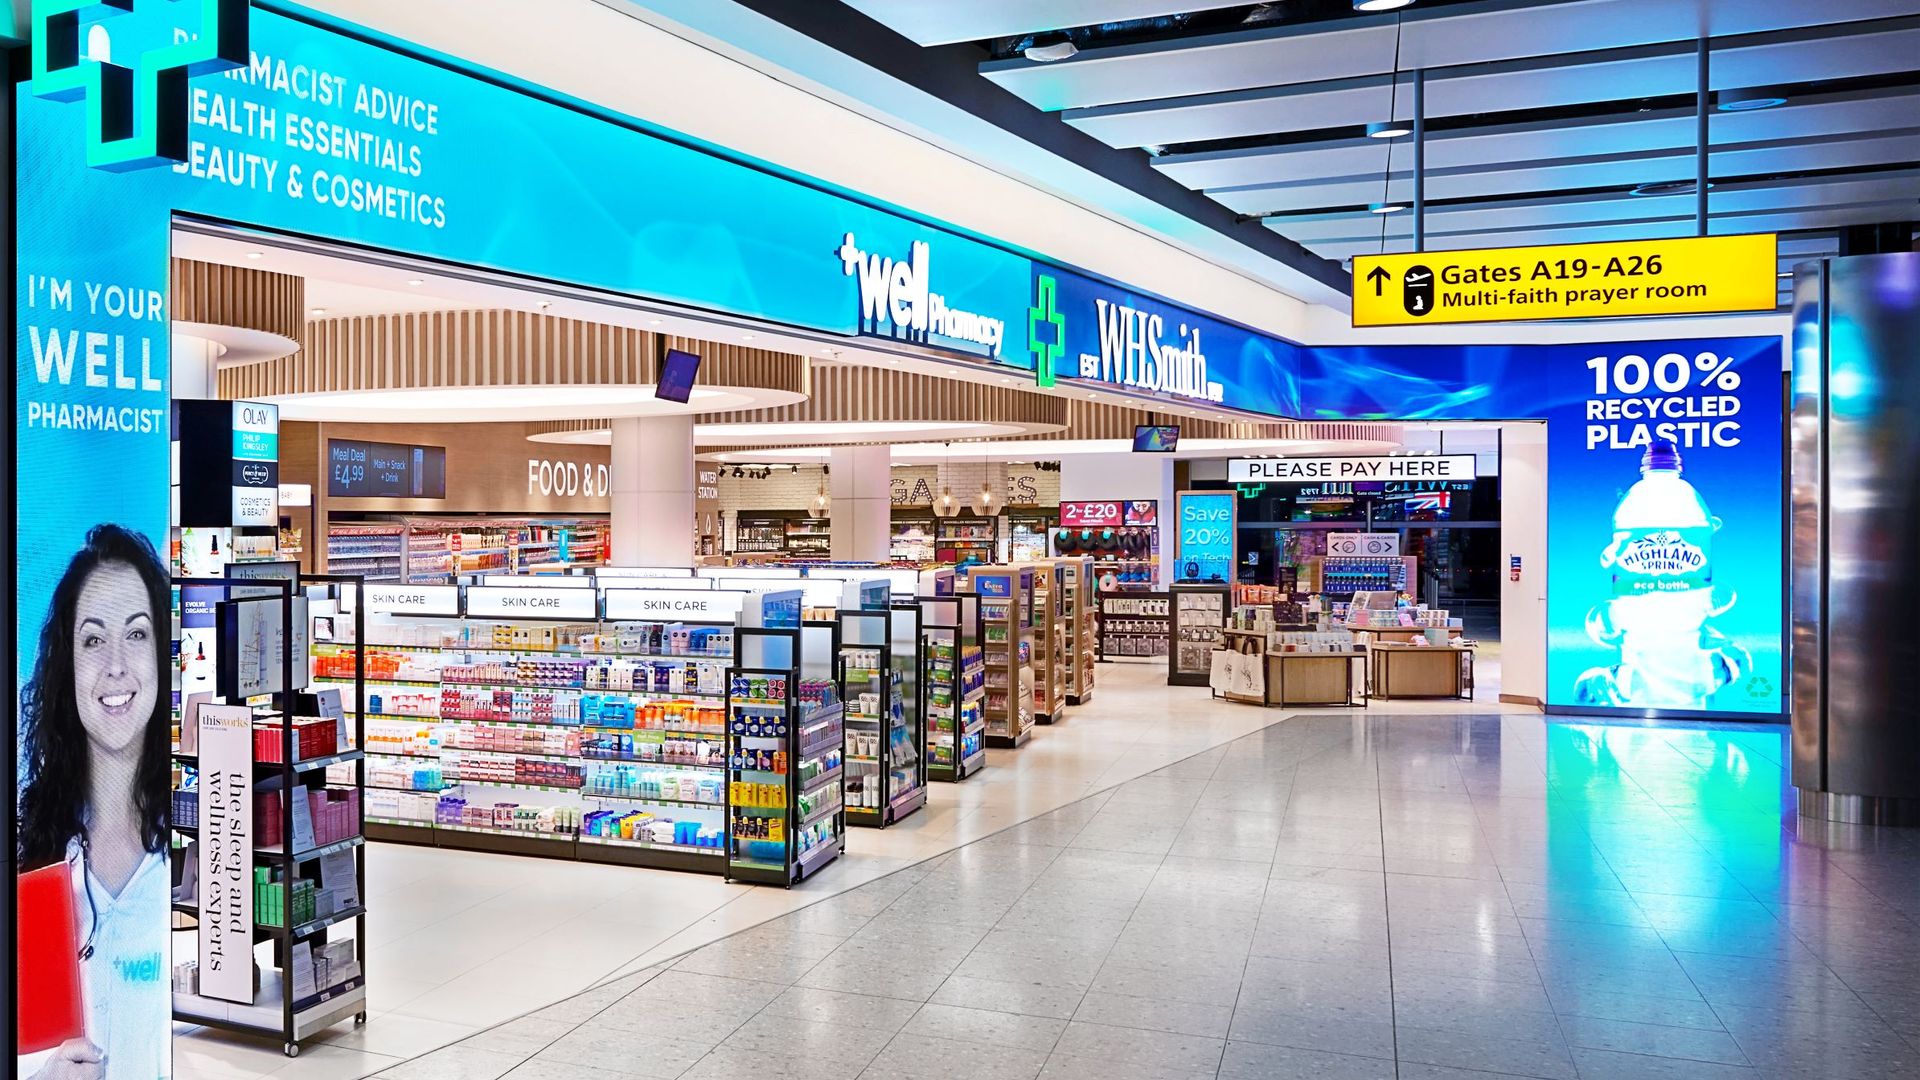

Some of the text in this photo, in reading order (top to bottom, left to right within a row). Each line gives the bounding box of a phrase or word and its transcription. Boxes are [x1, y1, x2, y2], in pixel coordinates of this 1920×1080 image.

[354, 86, 438, 136] ADVICE
[189, 88, 422, 178] EALTH ESSENTIALS
[286, 164, 305, 199] &
[312, 174, 446, 229] COSMETICS
[1441, 254, 1663, 286] Gates A19-A26
[28, 274, 163, 322] I'M YOUR
[1442, 281, 1708, 308] Multi-faith prayer room
[929, 292, 1005, 356] Pharmacy
[1080, 298, 1208, 399] EST WHSmith
[28, 325, 162, 392] WELL
[1586, 351, 1741, 396] 100%
[28, 401, 164, 434] PHARMACIST
[243, 407, 269, 425] OLAY
[1586, 395, 1741, 421] RECYCLED
[1586, 420, 1741, 451] PLASTIC
[333, 448, 366, 462] Meal Deal
[373, 459, 386, 469] Main
[390, 460, 406, 470] Snack
[335, 464, 364, 489] £4.99
[385, 473, 399, 483] Drink
[528, 459, 579, 497] FOOD
[583, 463, 594, 497] &
[699, 471, 717, 484] WATER
[1249, 460, 1451, 478] PLEASE PAY HERE
[698, 487, 718, 499] STATION
[1066, 504, 1077, 519] 2
[1083, 503, 1117, 518] £20
[1184, 506, 1230, 522] Save
[1184, 528, 1230, 545] 20%
[1184, 553, 1198, 562] on
[1624, 548, 1701, 567] HIGHLAND
[1641, 561, 1683, 571] SPRING
[1633, 579, 1690, 590] eco bottle
[372, 594, 426, 605] SKIN CARE
[502, 597, 561, 608] SKIN CARE
[643, 600, 708, 611] SKIN CARE
[202, 714, 248, 729] thisworks
[224, 772, 246, 935] the sleep and
[206, 769, 226, 972] wellness experts
